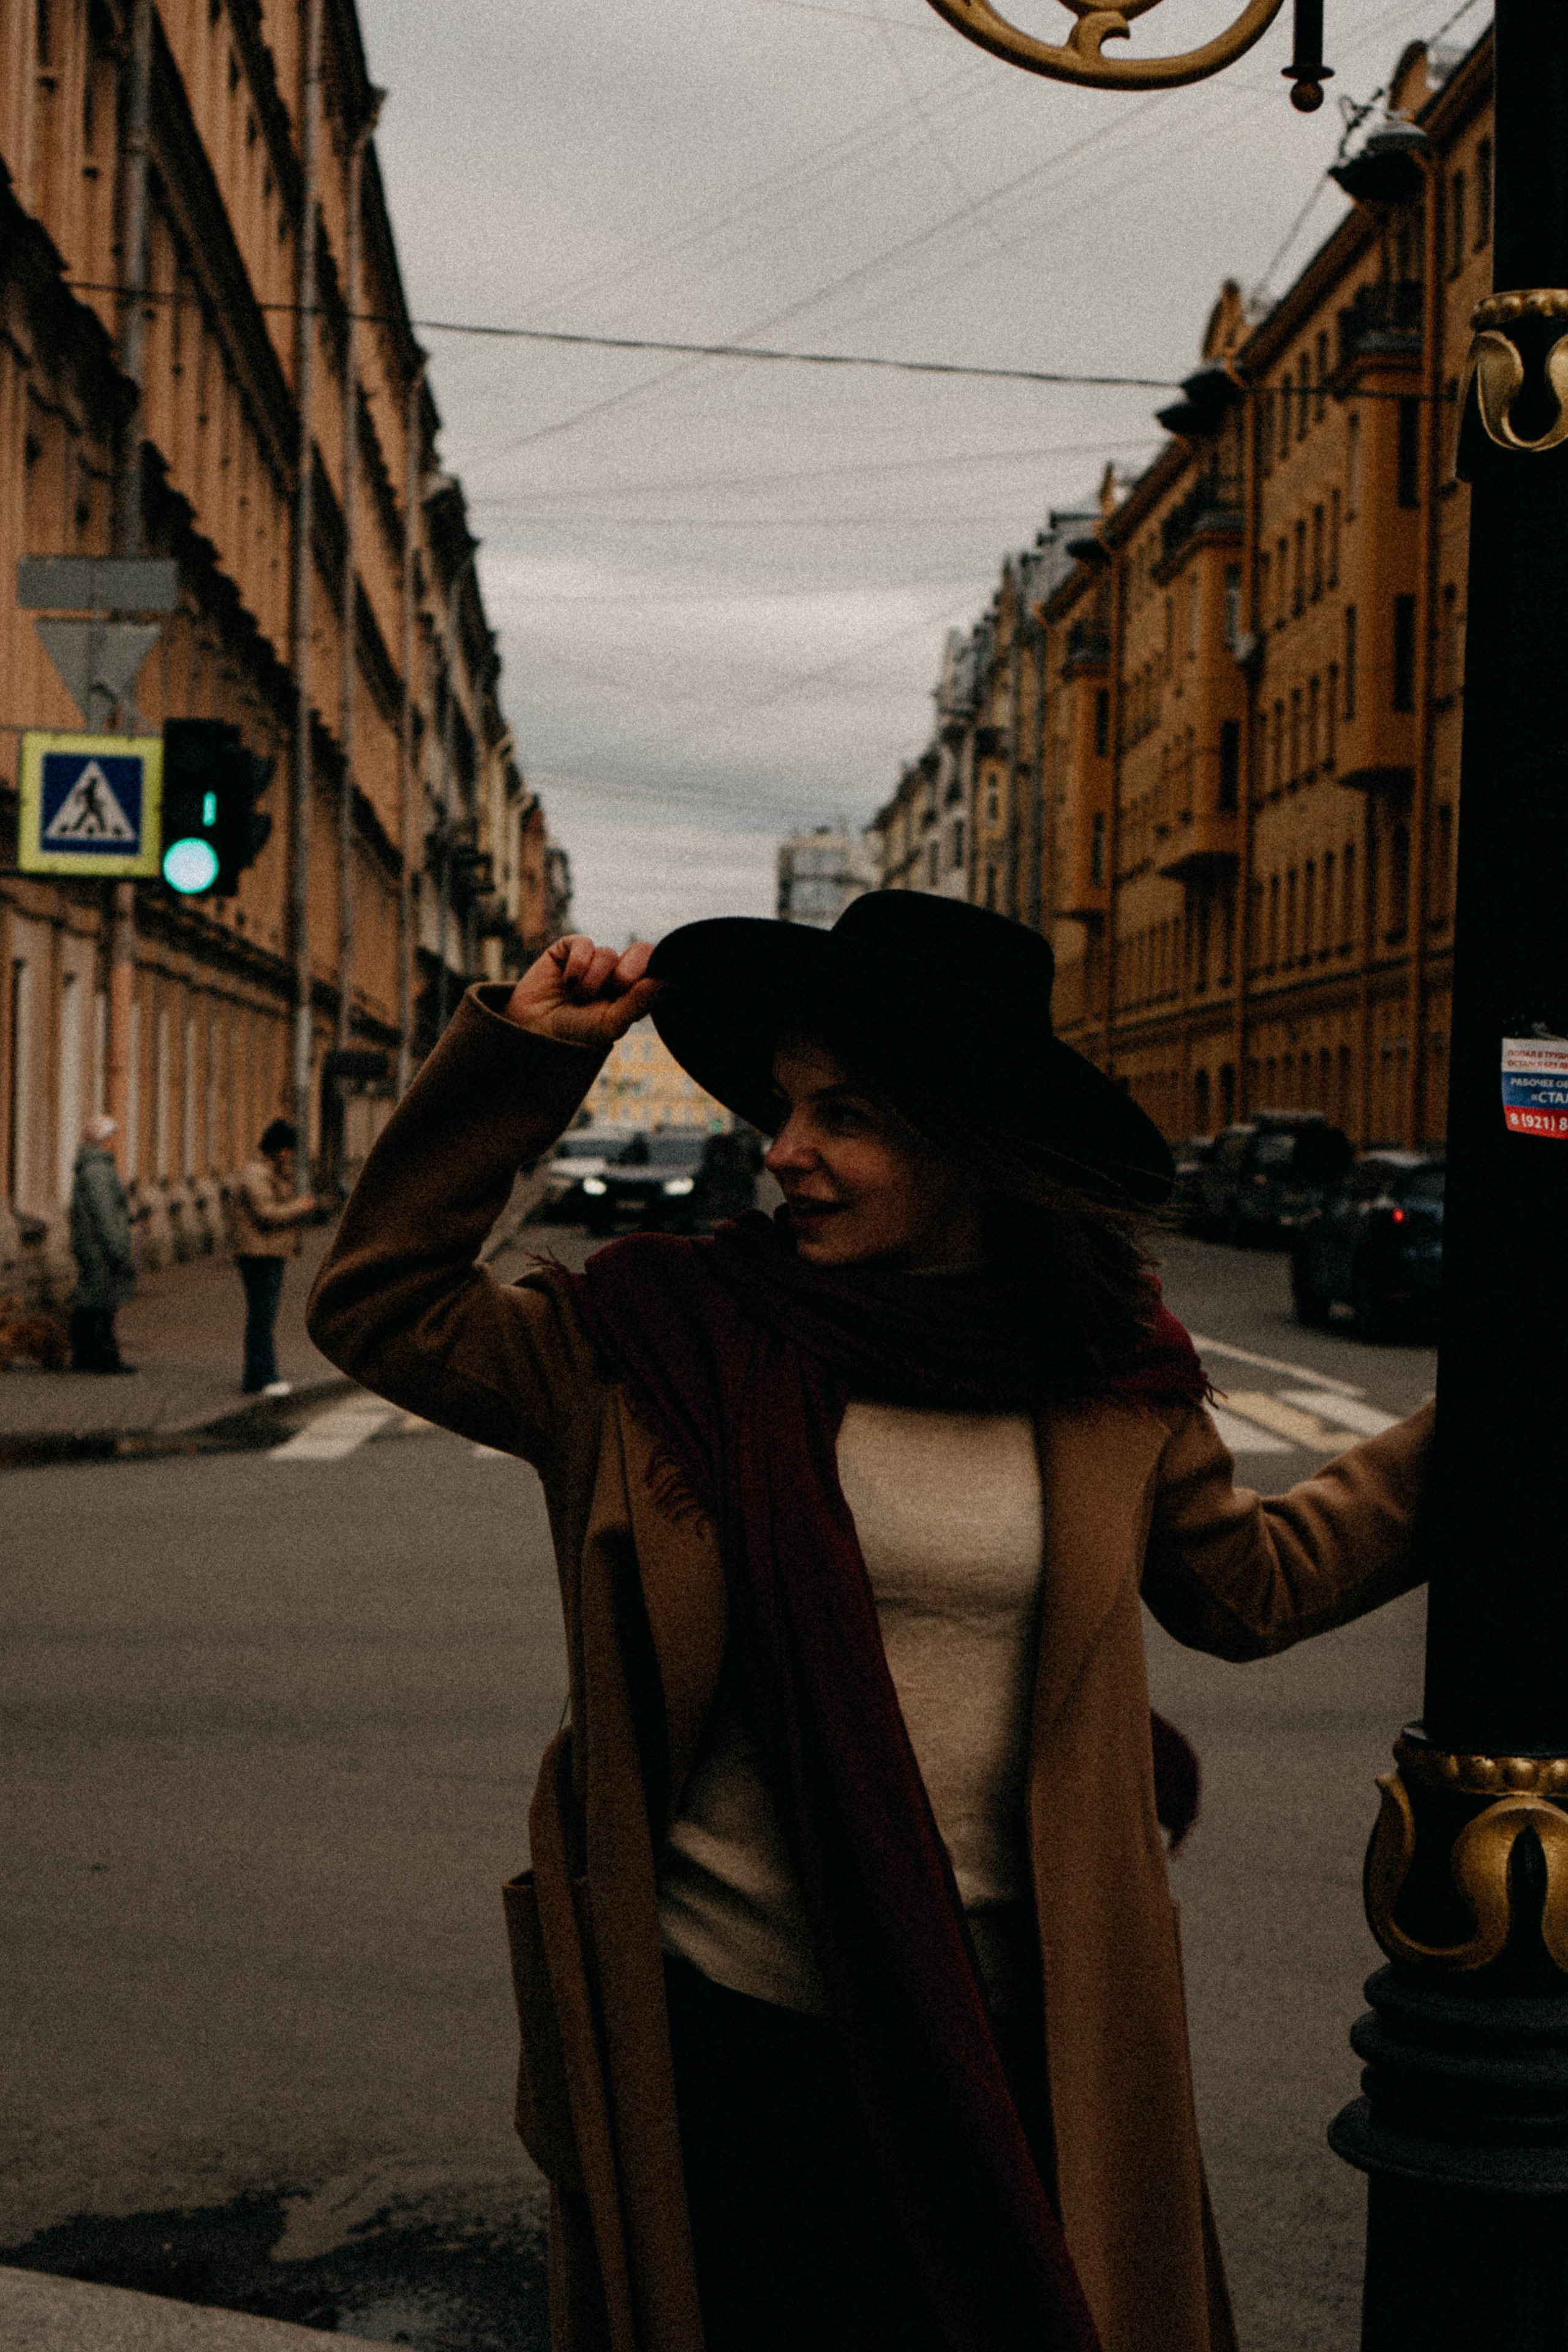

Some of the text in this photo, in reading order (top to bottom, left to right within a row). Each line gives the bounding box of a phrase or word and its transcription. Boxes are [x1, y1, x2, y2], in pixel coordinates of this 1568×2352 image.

[1510, 1078, 1555, 1087] РАБОЧЕЕ
[1510, 1113, 1519, 1125] 8
[1521, 1114, 1556, 1132] (921)
